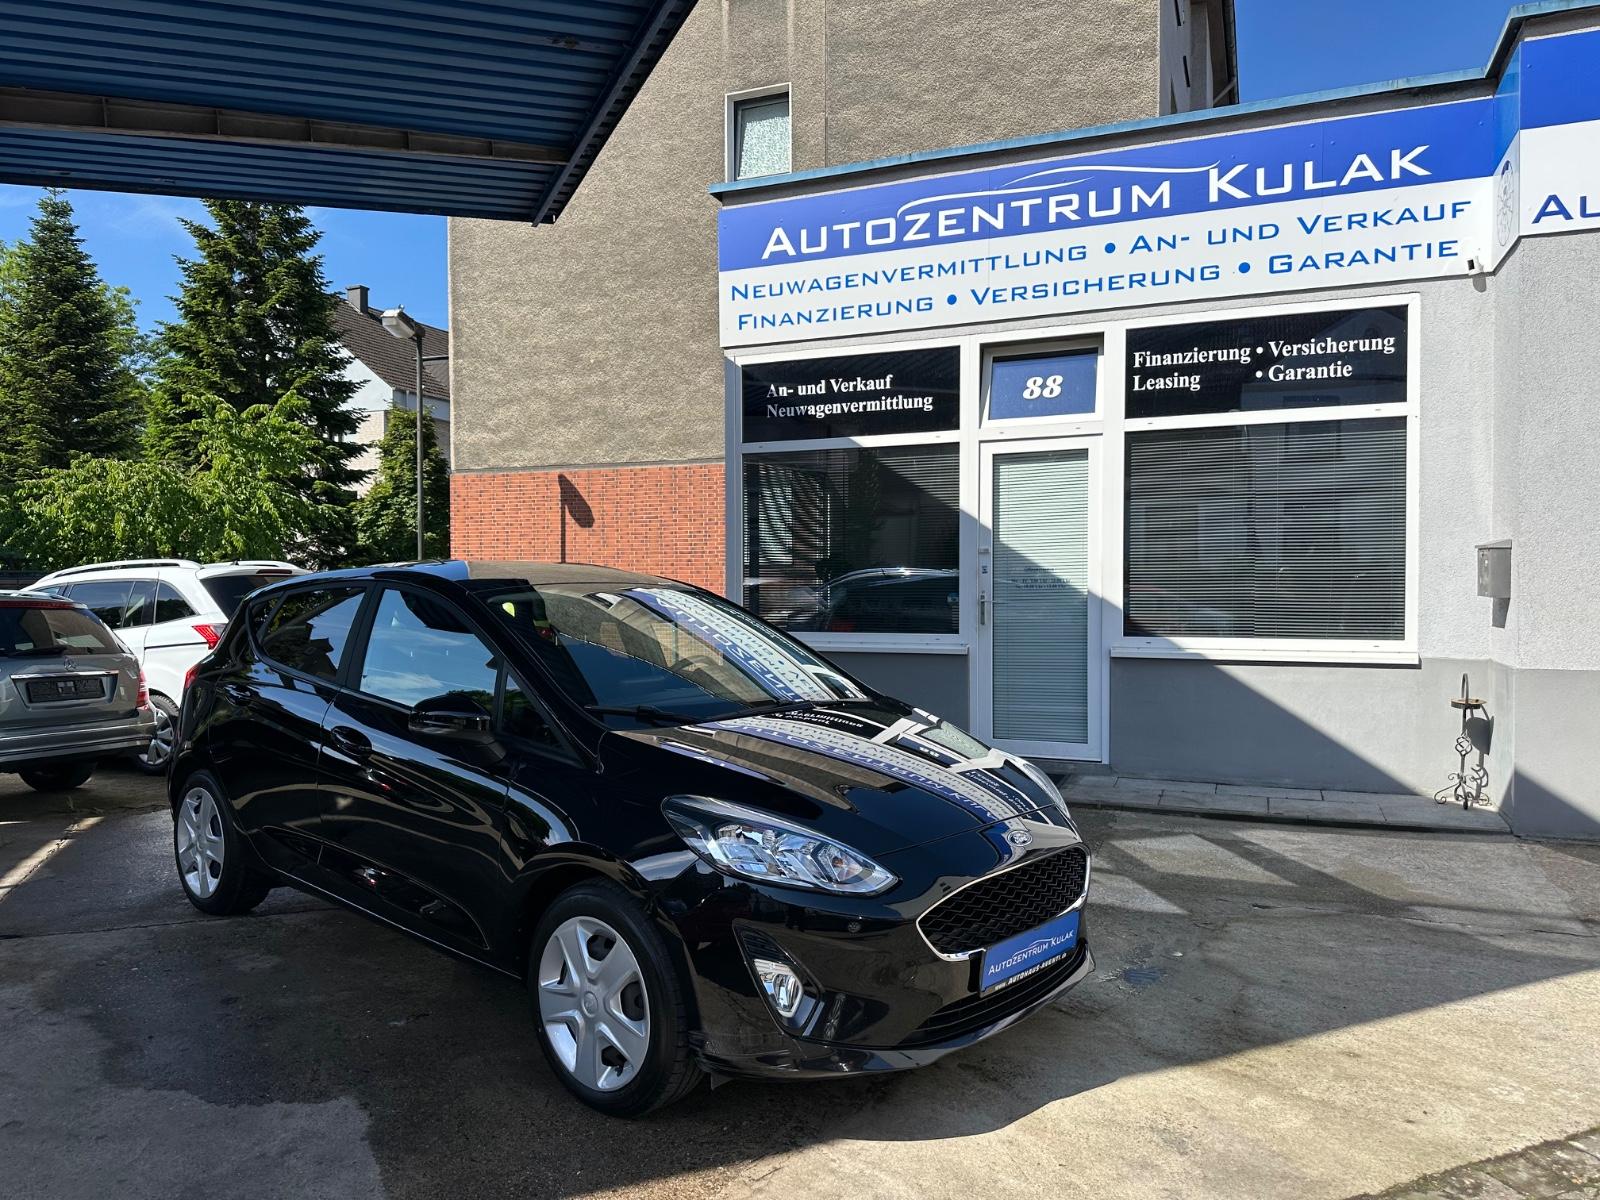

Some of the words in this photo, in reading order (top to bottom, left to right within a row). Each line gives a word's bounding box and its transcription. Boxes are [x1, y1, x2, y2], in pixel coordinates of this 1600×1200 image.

[761, 178, 1171, 260] AUTOZENTRUM
[1208, 145, 1432, 203] KULAK
[731, 245, 1087, 301] NEUWAGENVERMITTLUNG
[1207, 223, 1280, 245] UND
[1297, 201, 1472, 235] VERKAUF
[738, 297, 933, 330] FINANZIERUNG
[970, 265, 1220, 305] VERSICHERUNG
[1268, 240, 1458, 274] GARANTIE
[1133, 347, 1251, 368] Finanzierung
[1268, 336, 1396, 358] Versicherung
[766, 383, 794, 398] An-
[797, 380, 826, 395] und
[829, 374, 894, 393] Verkauf
[1022, 375, 1064, 400] 88
[1133, 372, 1201, 391] Leasing
[1268, 361, 1353, 382] Garantie
[766, 395, 933, 418] Neuwagenvermittlung
[988, 943, 1048, 976] AUTOZENTRUM
[1050, 930, 1074, 946] KULAK
